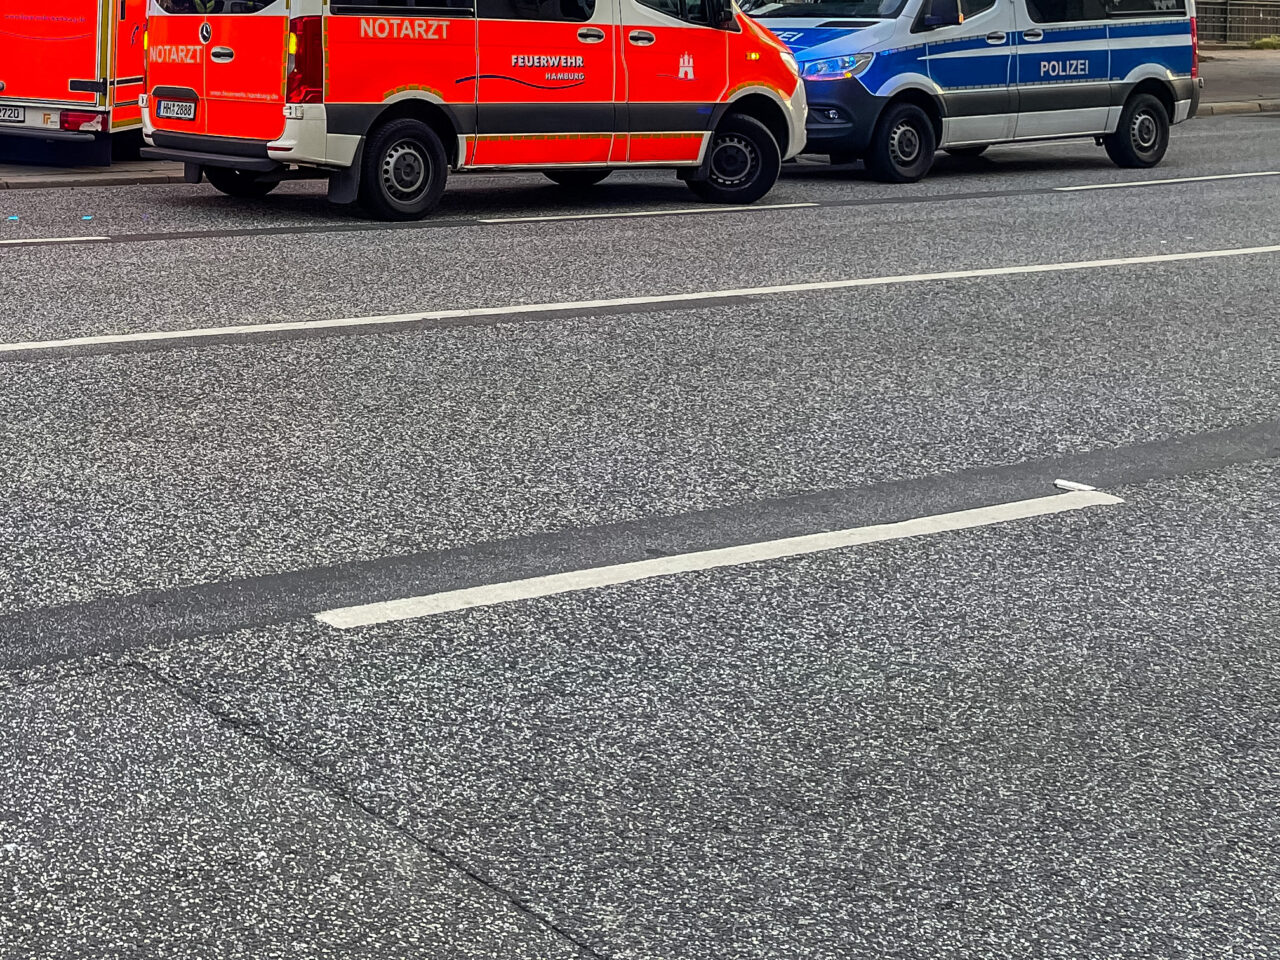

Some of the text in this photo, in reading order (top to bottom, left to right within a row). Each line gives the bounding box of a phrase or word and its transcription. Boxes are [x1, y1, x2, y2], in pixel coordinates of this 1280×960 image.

[360, 18, 450, 39] NOTARZT
[150, 45, 202, 63] NOTARZT
[511, 55, 585, 68] FEUERWEHR
[545, 72, 585, 81] HAMBURG
[1040, 59, 1089, 77] POLIZEI
